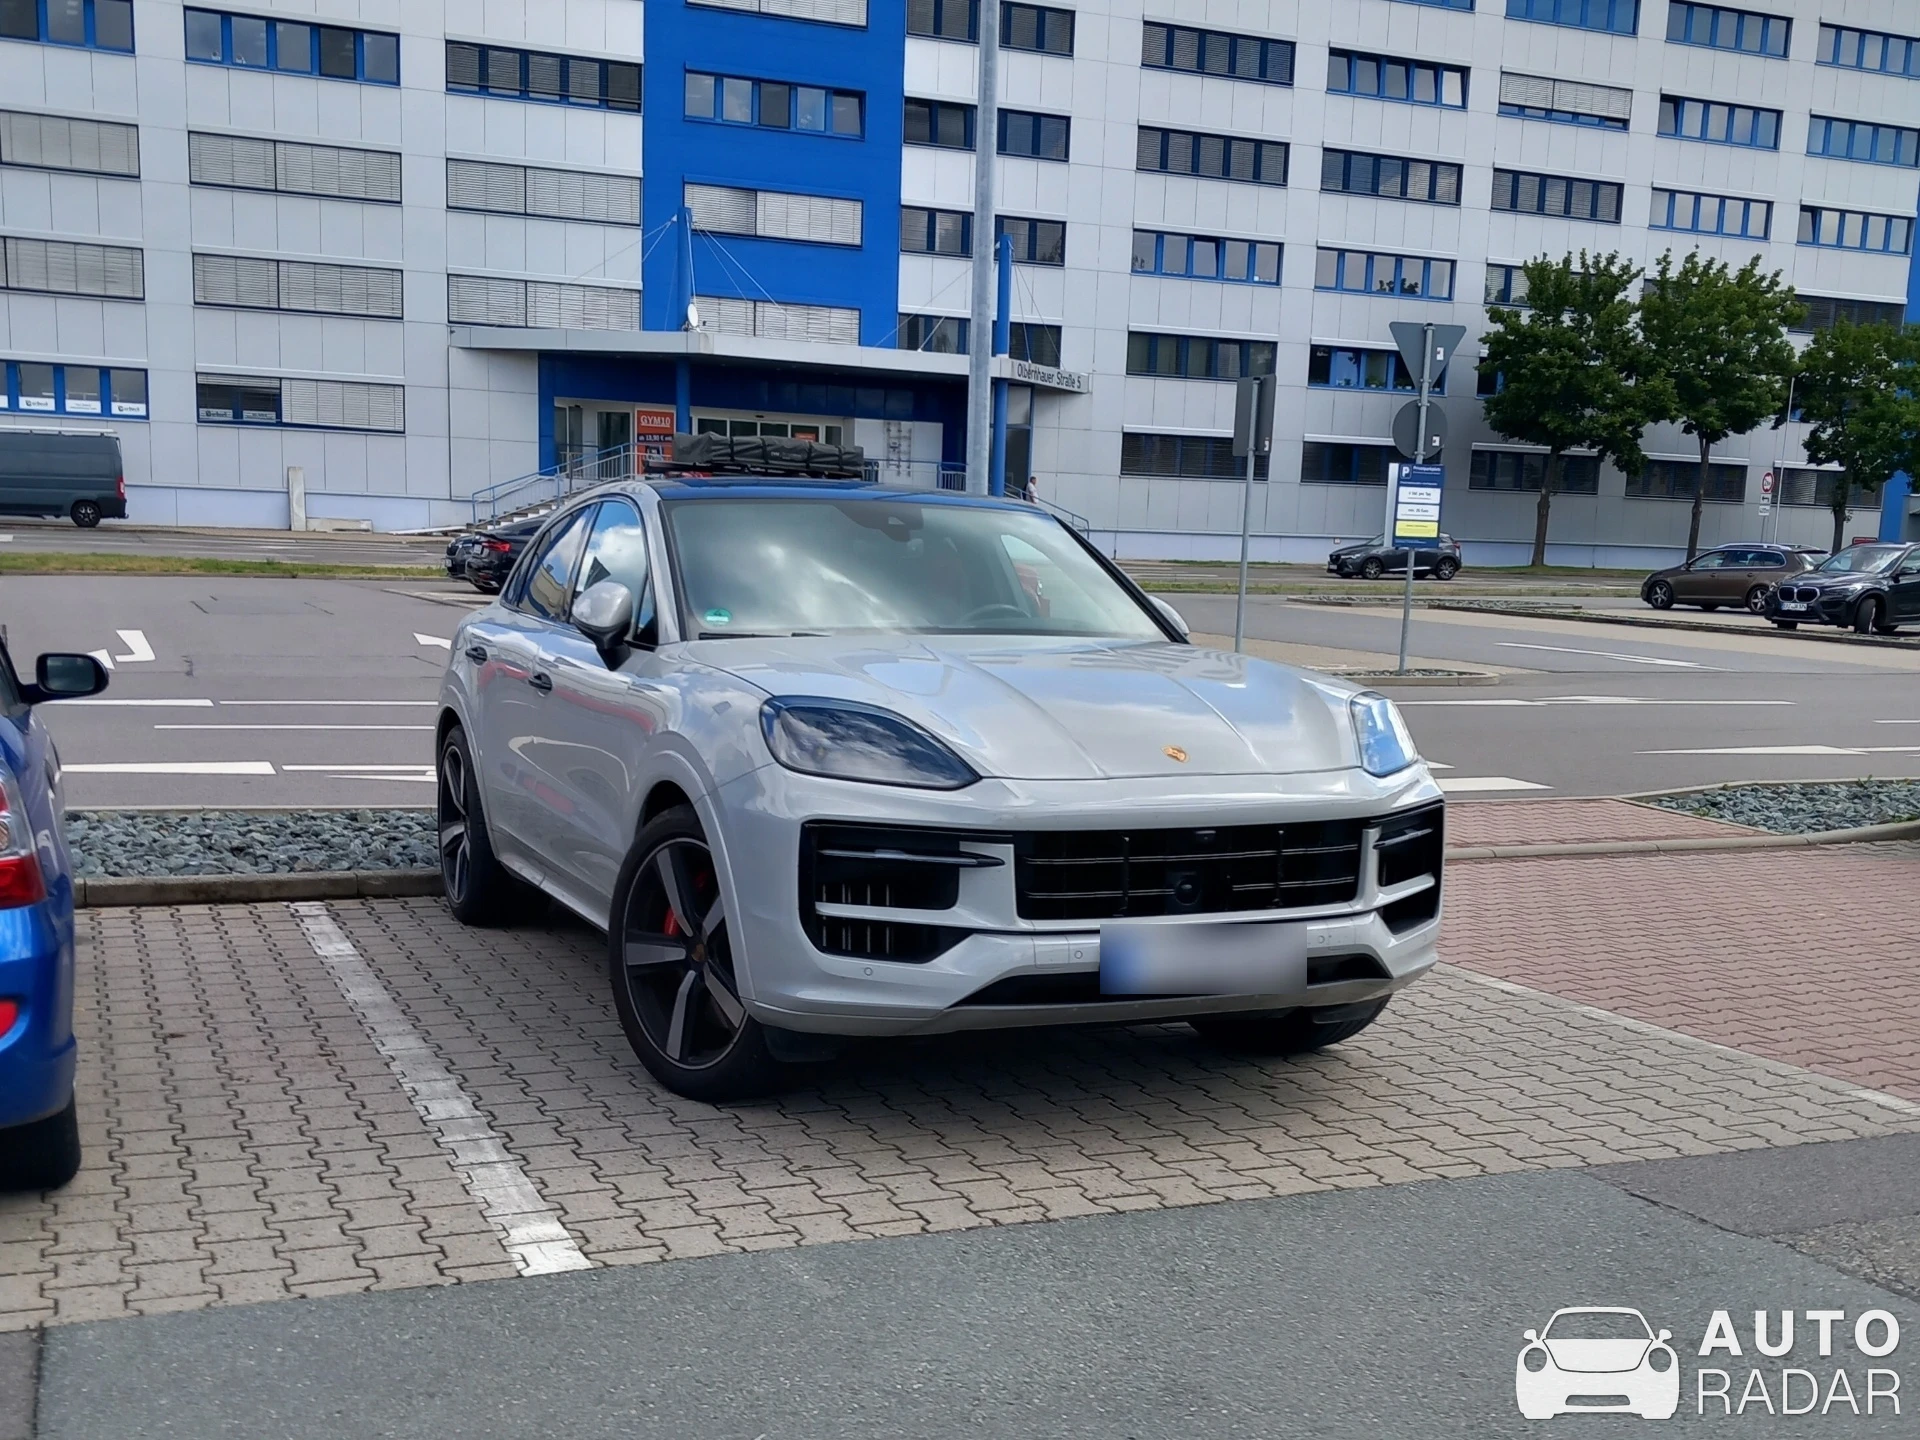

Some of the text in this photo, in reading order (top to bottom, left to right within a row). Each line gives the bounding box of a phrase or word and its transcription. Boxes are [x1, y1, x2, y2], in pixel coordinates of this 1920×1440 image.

[1018, 364, 1082, 388] Olbernhauer Straße 5
[640, 415, 671, 426] GYM10
